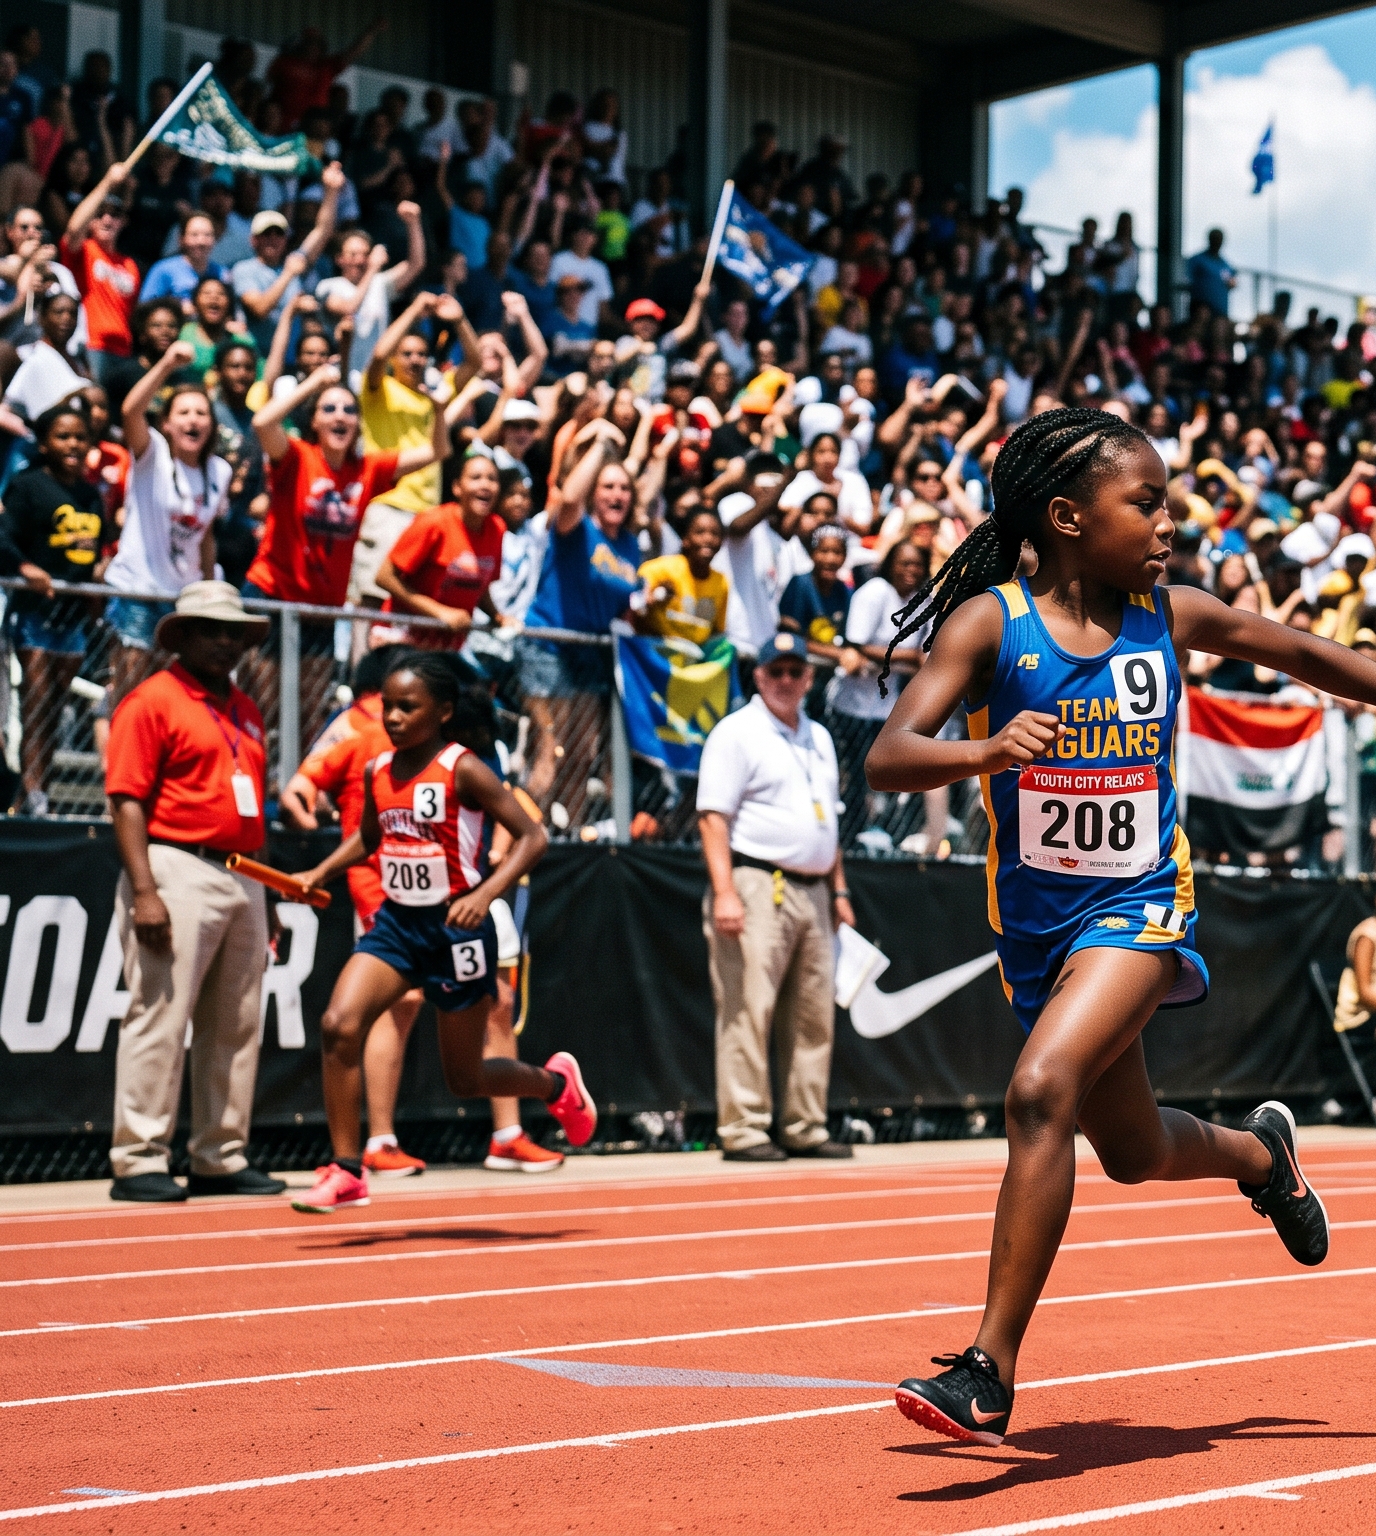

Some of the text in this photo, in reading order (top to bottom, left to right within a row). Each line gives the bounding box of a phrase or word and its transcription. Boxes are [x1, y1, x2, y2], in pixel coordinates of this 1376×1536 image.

[1124, 658, 1157, 716] 9
[1056, 697, 1122, 723] TEAM
[1044, 722, 1161, 760] GUARS
[1033, 771, 1145, 790] YOUTH CITY RELAYS
[420, 787, 437, 819] 3
[1040, 799, 1136, 852] 208
[388, 861, 432, 890] 208
[459, 945, 479, 976] 3
